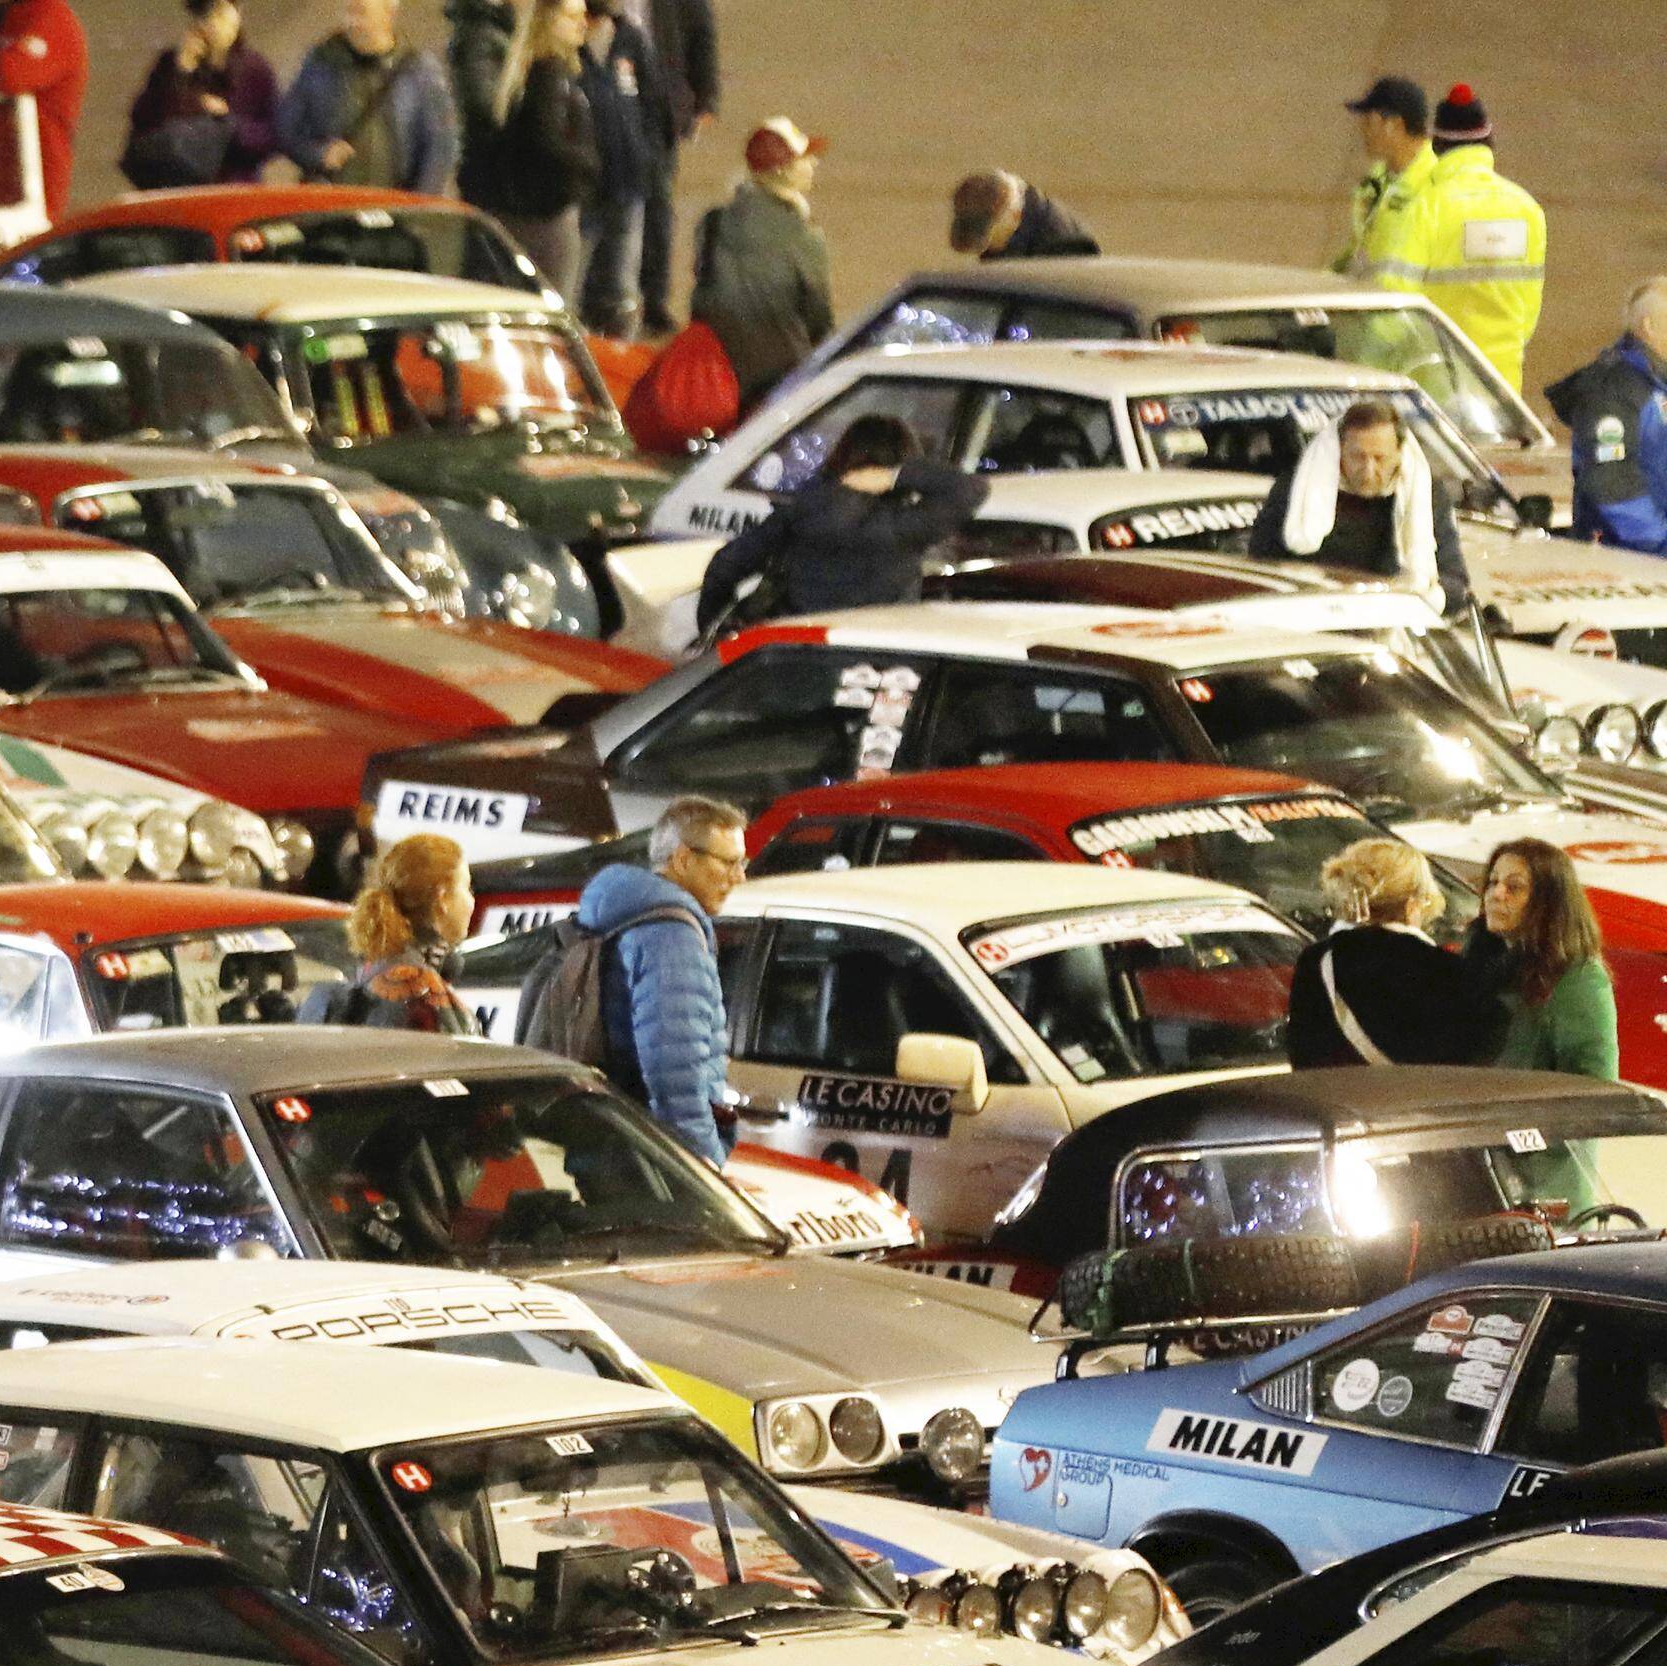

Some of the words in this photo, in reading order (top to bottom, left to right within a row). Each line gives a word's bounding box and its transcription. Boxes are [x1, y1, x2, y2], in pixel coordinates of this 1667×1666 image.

[399, 790, 505, 827] REIMS
[98, 952, 128, 980] H
[277, 1099, 310, 1121] H
[802, 1079, 841, 1107] LE
[844, 1080, 953, 1119] CASINO
[1513, 1132, 1541, 1148] 122
[785, 1204, 881, 1250] rlboro
[270, 1298, 569, 1344] PORSCHE
[553, 1437, 586, 1454] 102
[1170, 1416, 1305, 1468] MILAN
[395, 1464, 430, 1490] H
